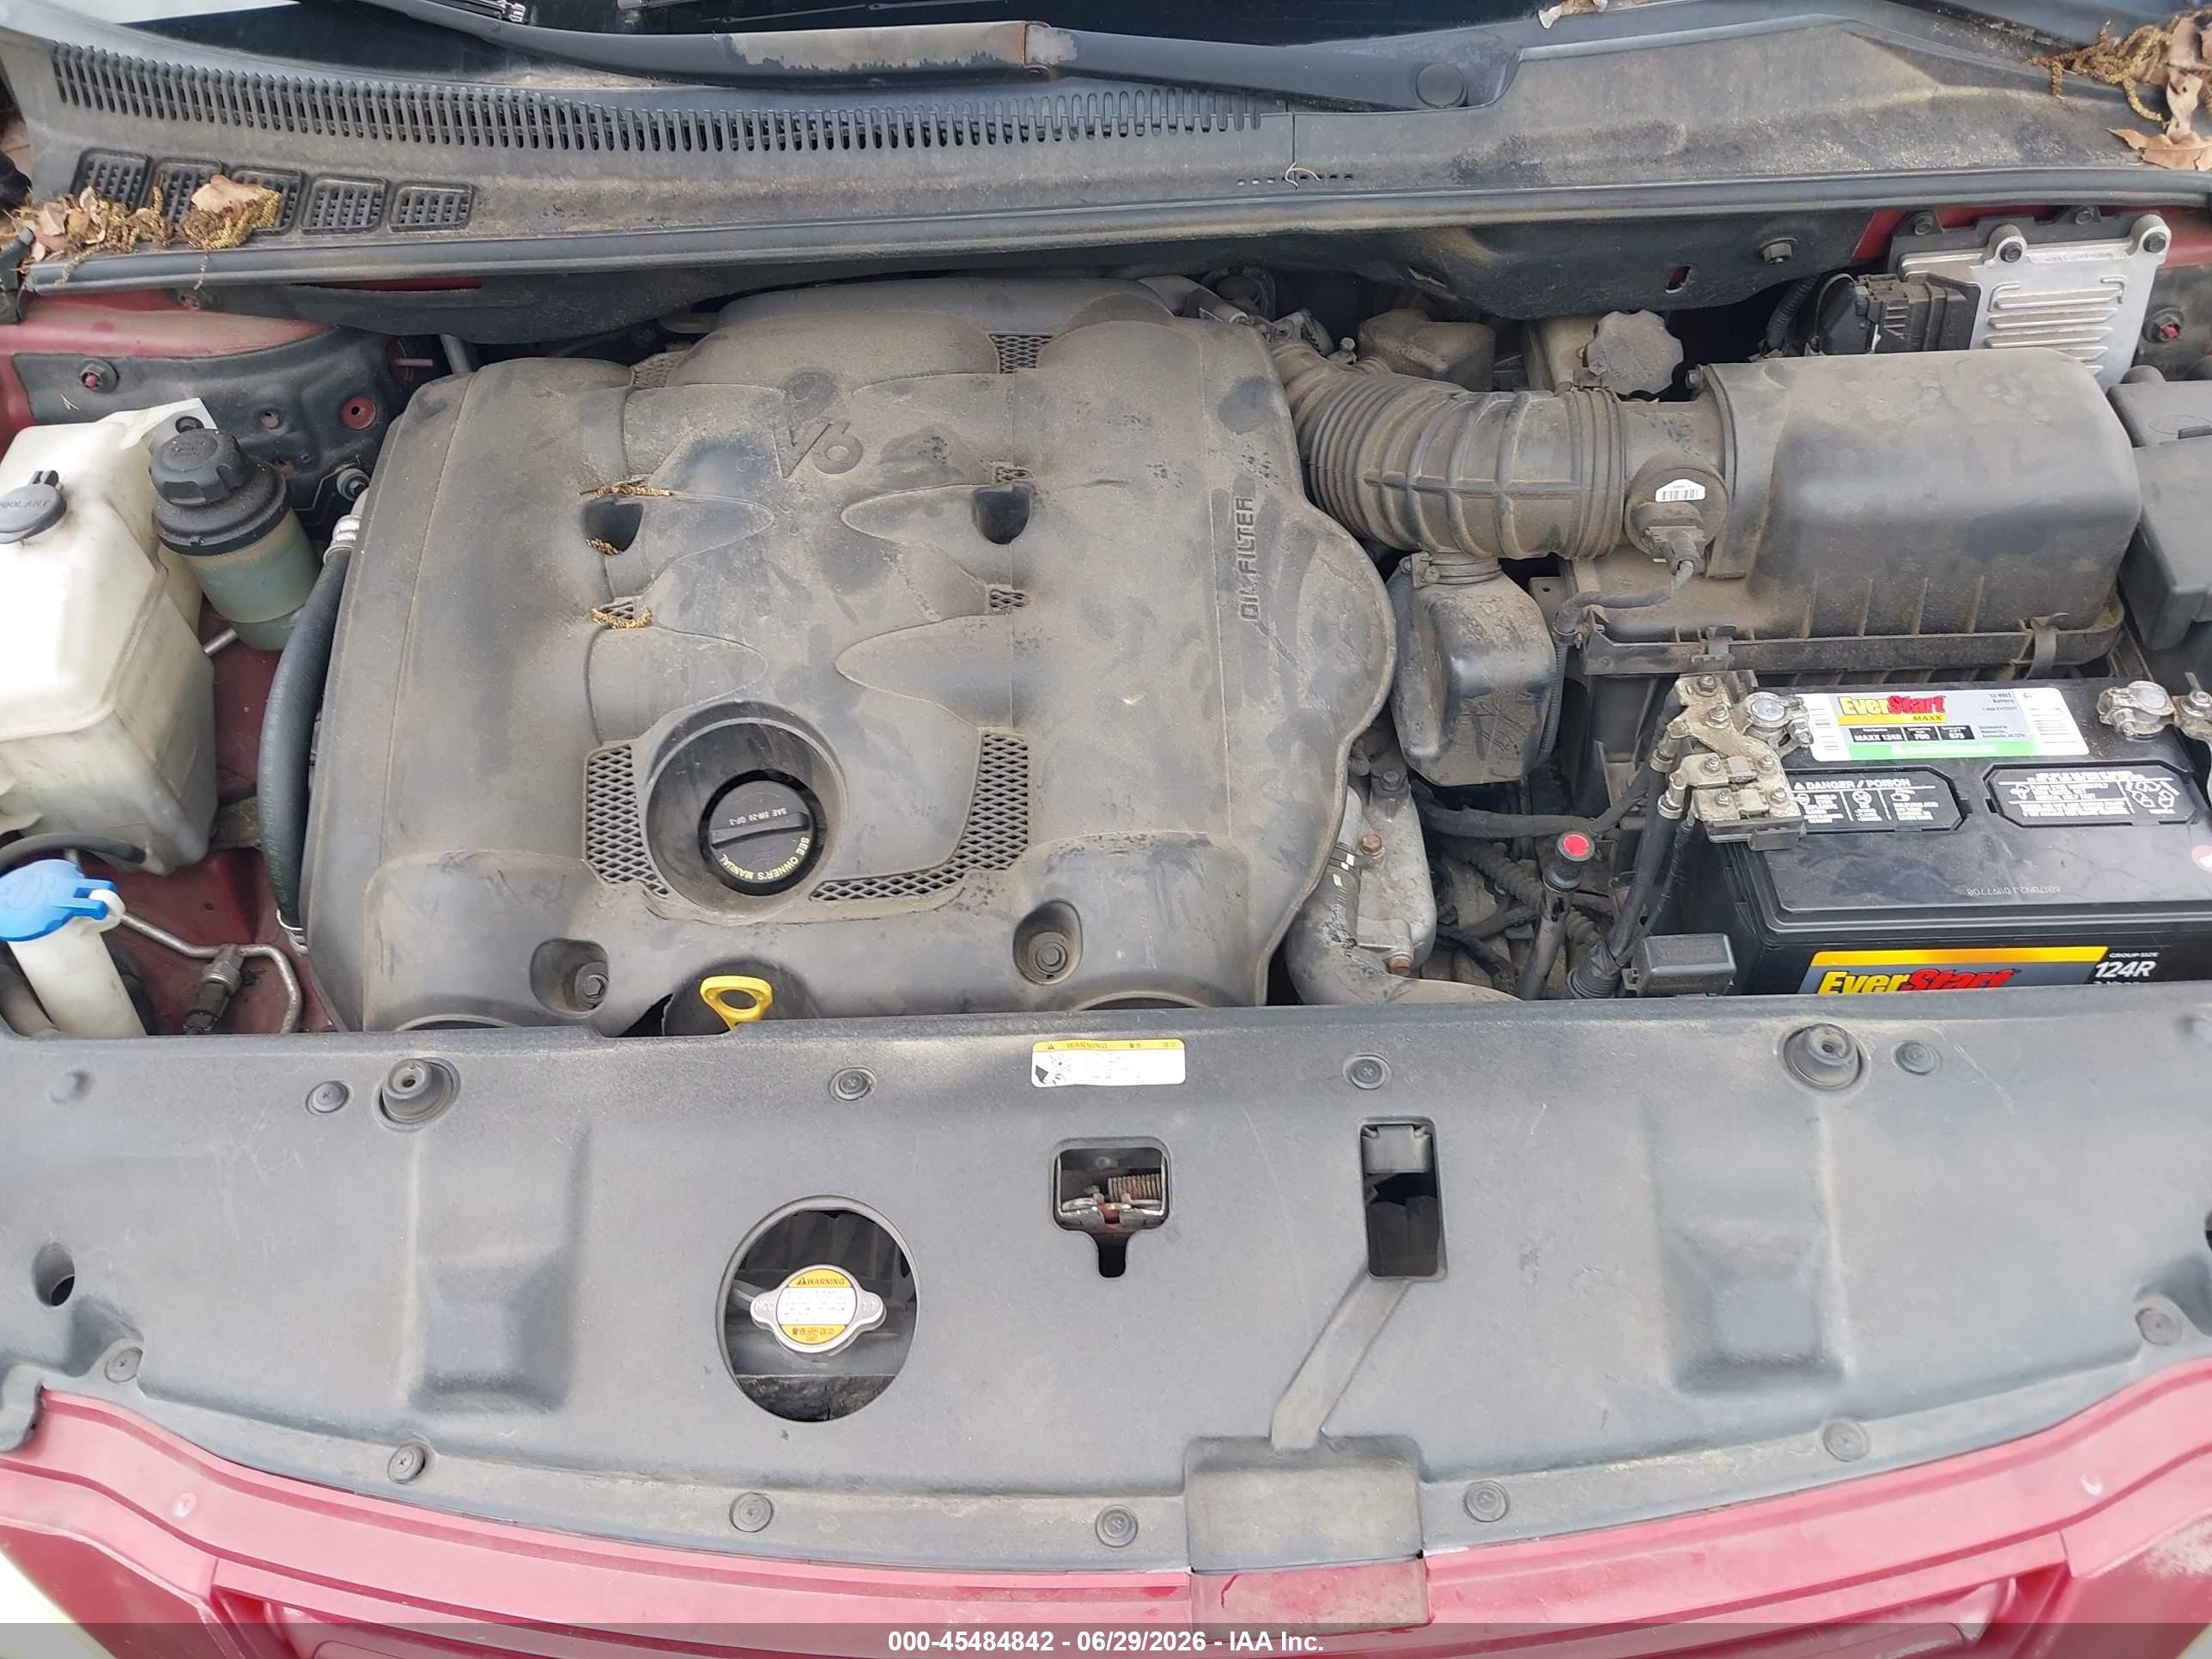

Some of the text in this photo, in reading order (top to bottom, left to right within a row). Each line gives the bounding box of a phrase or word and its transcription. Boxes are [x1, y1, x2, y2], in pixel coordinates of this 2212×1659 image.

[770, 419, 863, 478] V6
[1235, 497, 1260, 620] OIL FILTER
[1838, 696, 1946, 714] EverStart
[1806, 781, 1855, 789] DANGER
[1865, 779, 1911, 787] POISON
[720, 836, 810, 880] SEE OWNER'S MANUAL
[1817, 961, 2157, 996] EverStart 124R
[806, 1277, 845, 1285] WARNING
